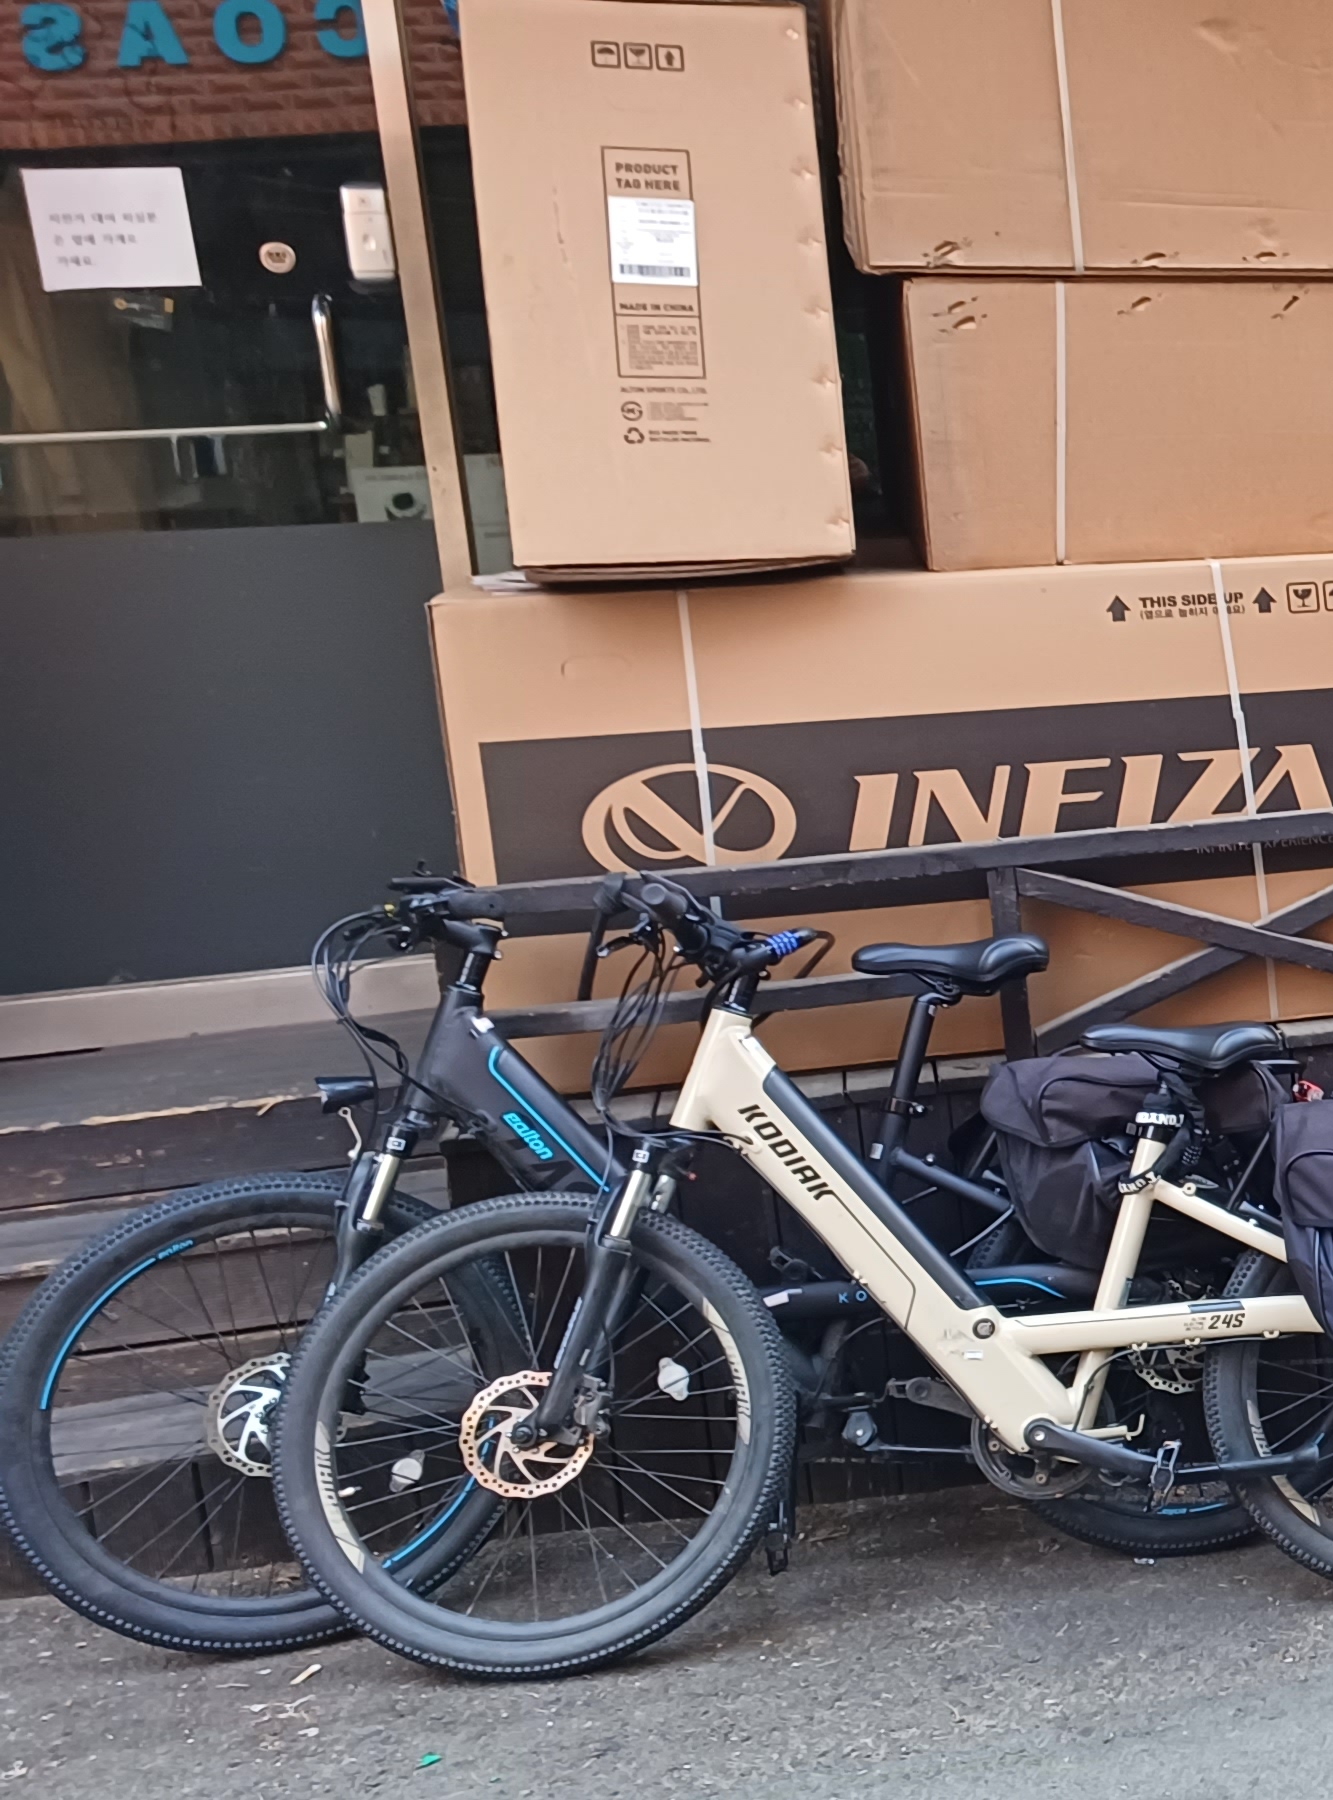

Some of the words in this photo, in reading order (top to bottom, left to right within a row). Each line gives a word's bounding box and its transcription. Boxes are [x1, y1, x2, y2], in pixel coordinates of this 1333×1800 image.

[615, 162, 679, 175] PRODUCT
[615, 178, 642, 189] TAG
[645, 180, 681, 191] HERE
[619, 302, 648, 312] MADE
[663, 303, 694, 312] CHINA
[1139, 596, 1178, 608] THIS
[1181, 594, 1217, 607] SIDE
[1223, 592, 1244, 604] UP
[737, 1104, 834, 1201] KODIAK
[1208, 1313, 1246, 1330] 24S
